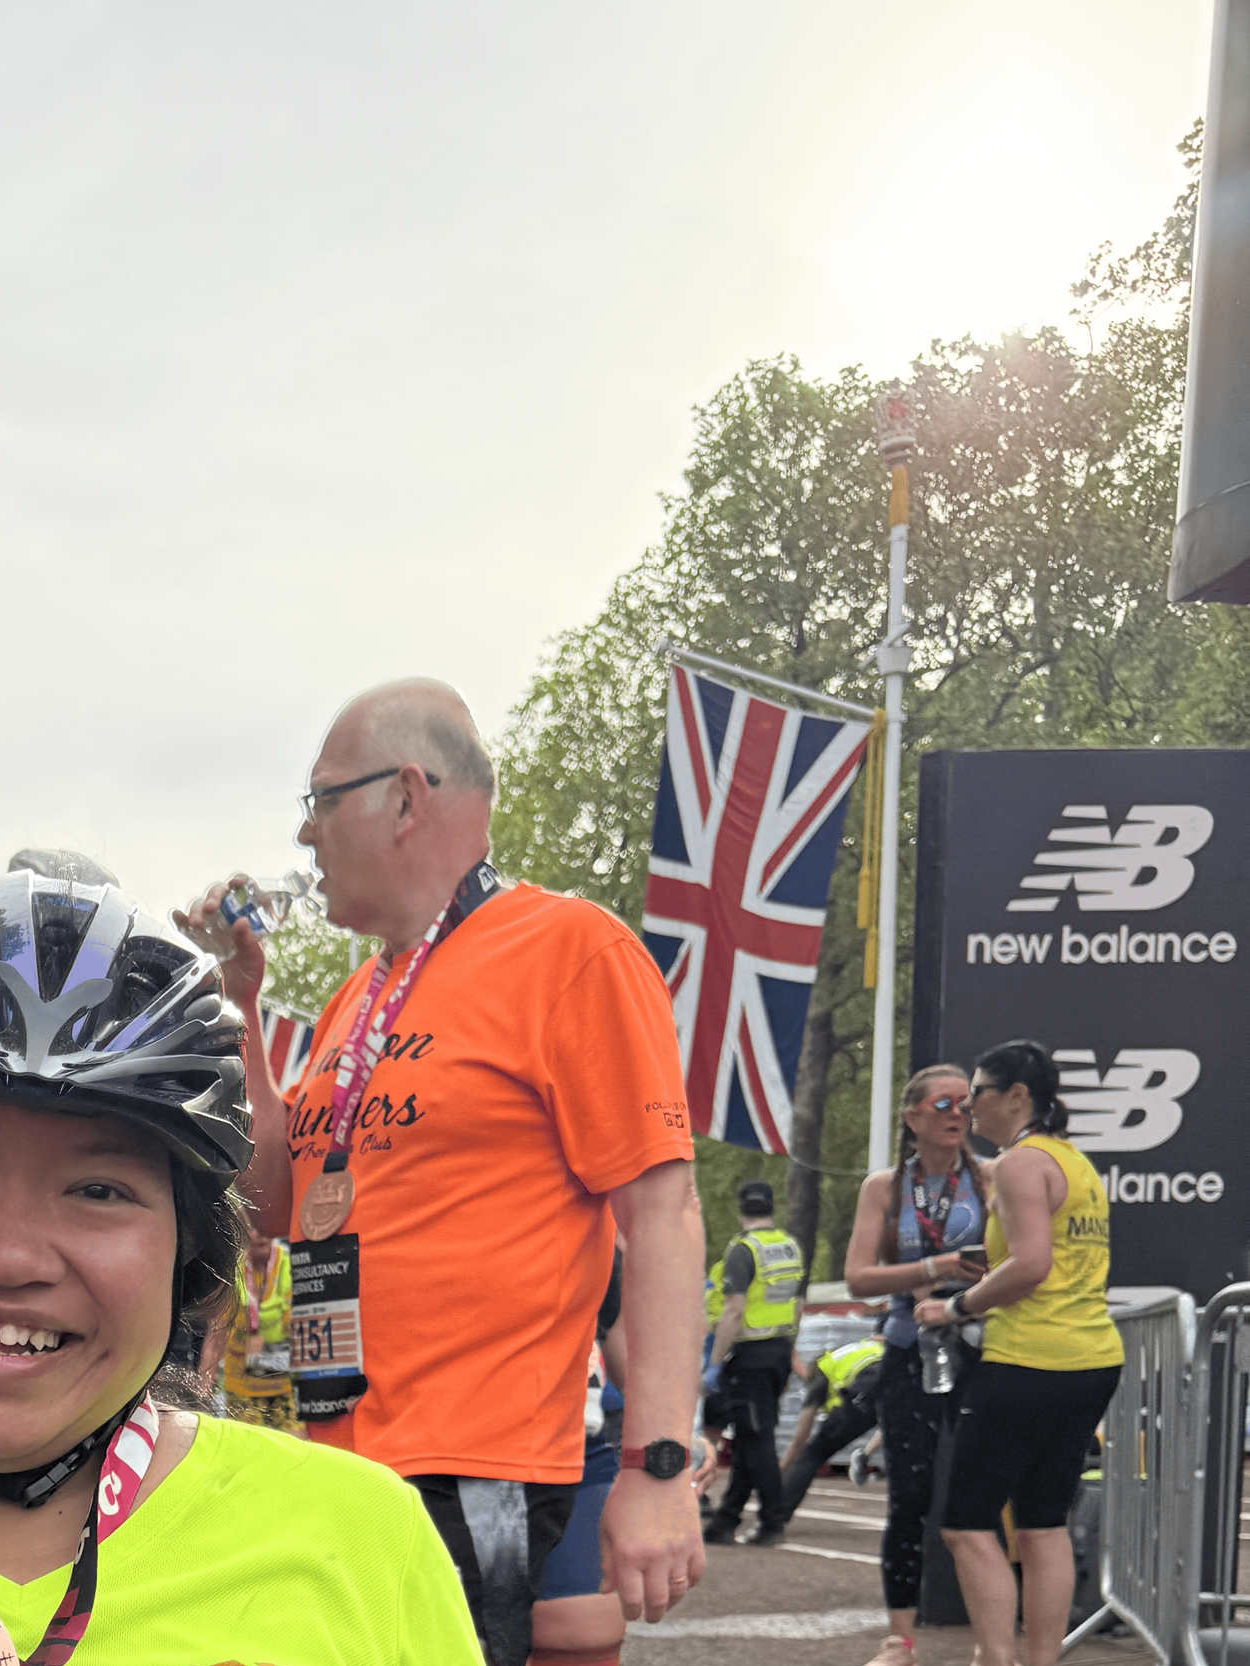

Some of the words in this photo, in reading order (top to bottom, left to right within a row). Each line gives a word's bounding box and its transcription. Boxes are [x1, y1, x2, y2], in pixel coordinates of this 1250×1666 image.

[1006, 804, 1214, 911] NB
[966, 933, 1052, 964] new
[1061, 924, 1238, 965] balance
[1103, 1165, 1224, 1203] lance
